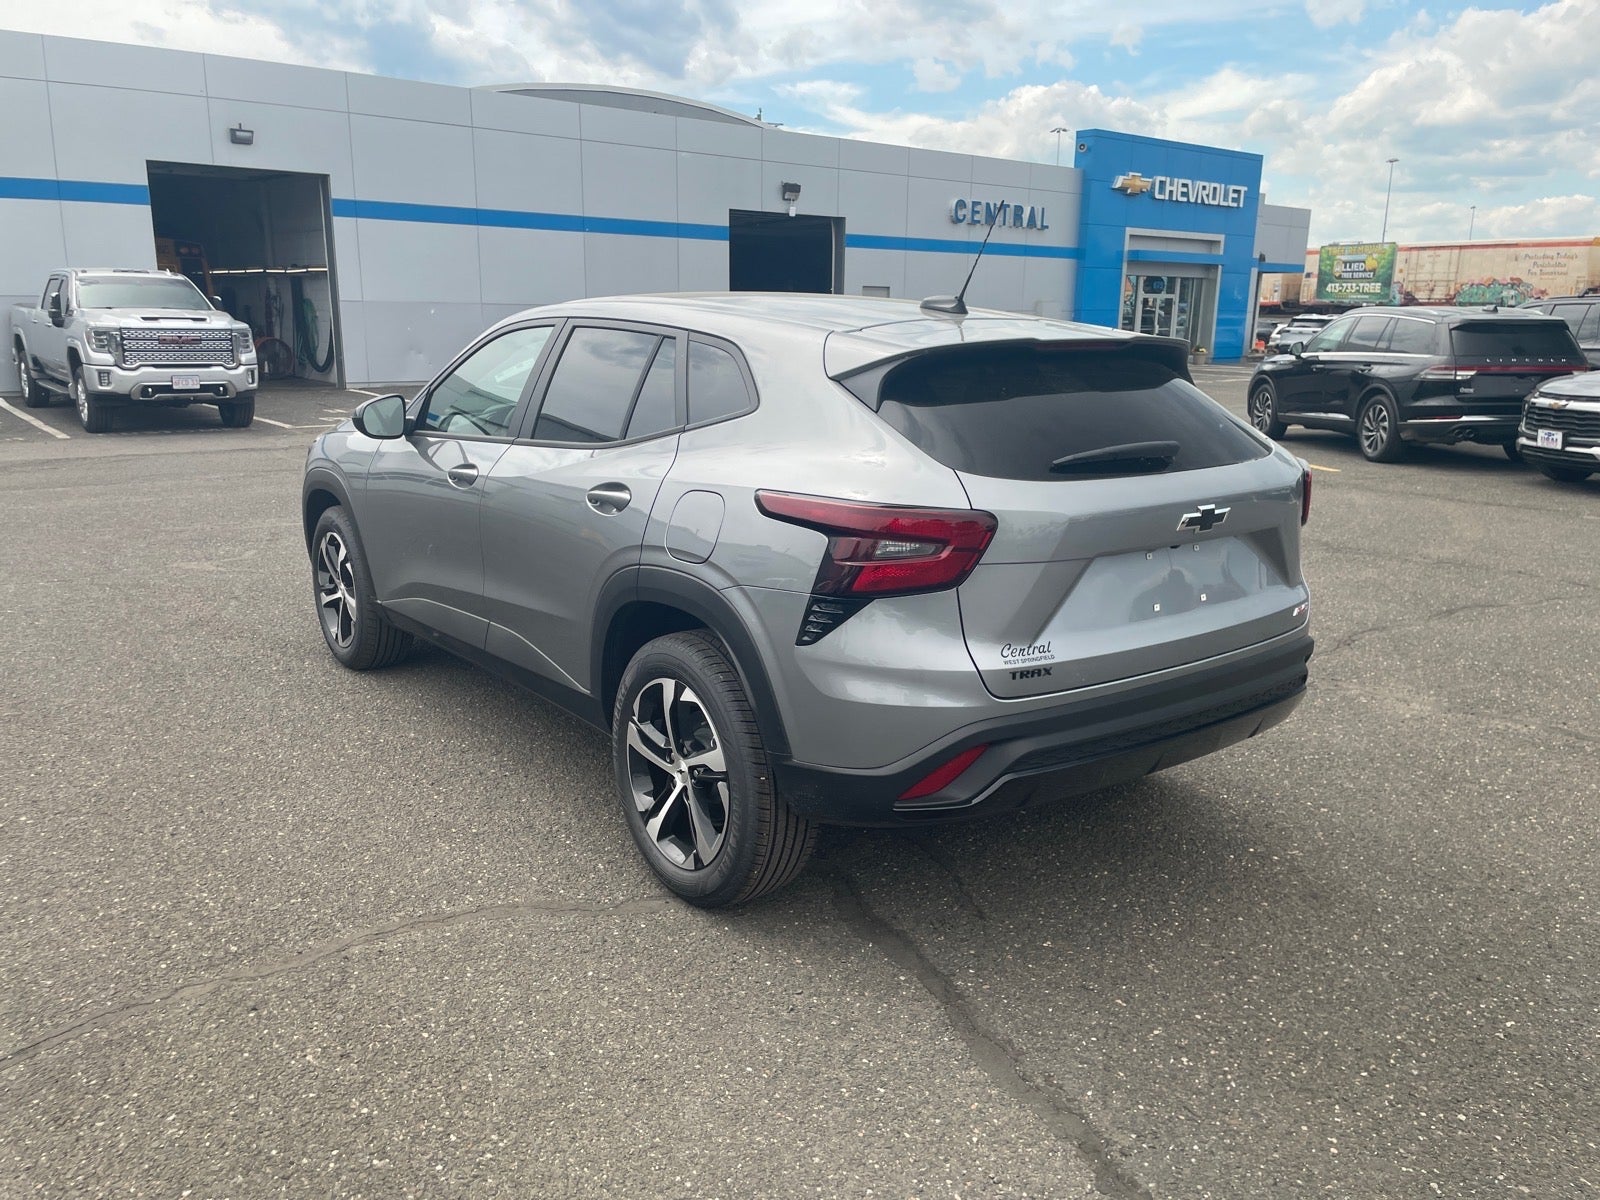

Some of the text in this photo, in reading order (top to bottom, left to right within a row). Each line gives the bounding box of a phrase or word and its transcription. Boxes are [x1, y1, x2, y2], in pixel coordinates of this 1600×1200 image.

[1154, 175, 1248, 208] CHEVROLET
[951, 198, 1049, 230] CENTRAL
[1326, 282, 1382, 293] 413-733-TREE
[159, 335, 201, 344] GMC
[1000, 641, 1051, 658] Central
[1009, 667, 1052, 680] TRAX
